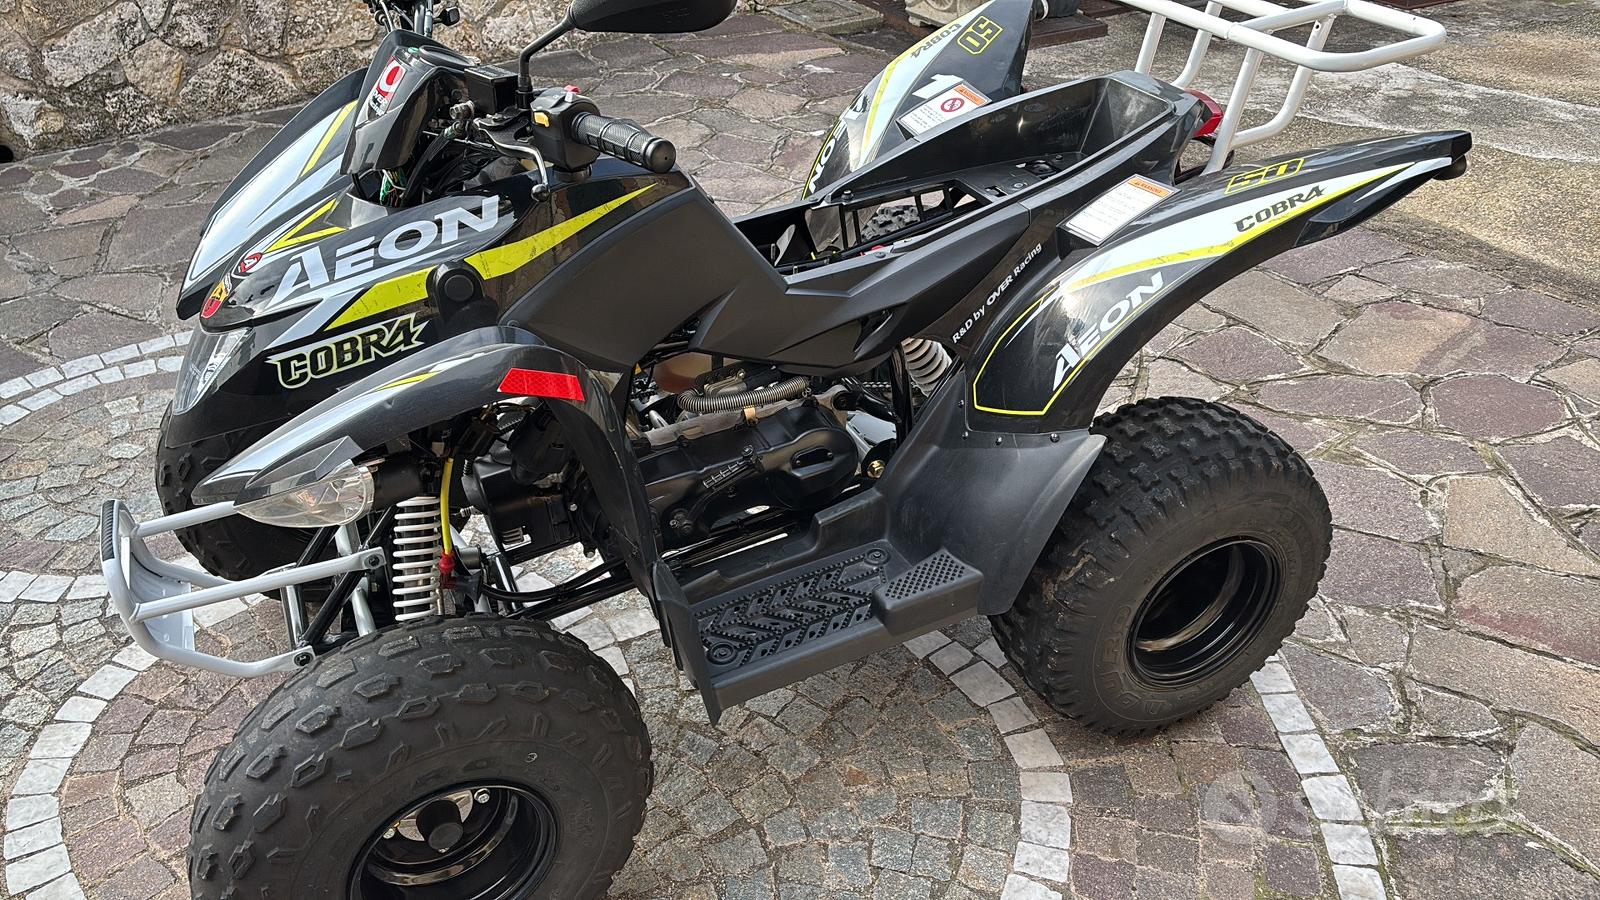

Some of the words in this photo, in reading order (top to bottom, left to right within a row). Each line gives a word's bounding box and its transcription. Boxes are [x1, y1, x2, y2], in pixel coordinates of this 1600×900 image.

[910, 23, 962, 58] COBRA
[957, 15, 1004, 55] 50
[1224, 158, 1305, 195] 50
[1233, 184, 1329, 233] COBRA
[264, 194, 499, 310] AEON
[952, 318, 974, 344] R&D
[972, 304, 985, 321] by
[986, 274, 1014, 306] OVER
[1013, 242, 1043, 277] Racing
[266, 313, 429, 389] COBRA
[1052, 271, 1164, 392] AEON
